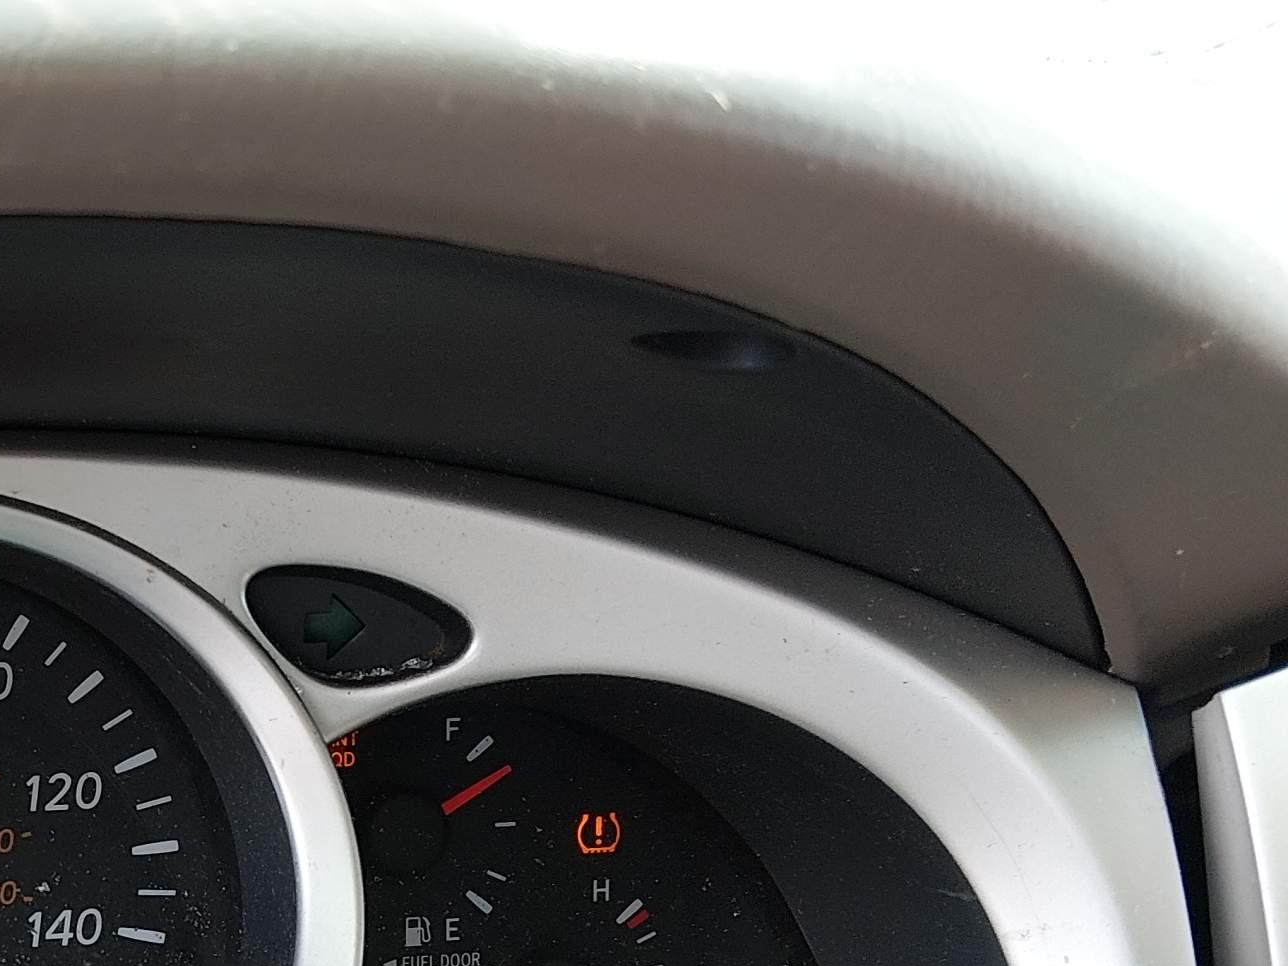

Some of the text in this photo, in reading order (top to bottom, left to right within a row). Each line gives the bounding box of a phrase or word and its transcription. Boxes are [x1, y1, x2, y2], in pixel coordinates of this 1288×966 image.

[446, 718, 461, 741] F
[26, 771, 103, 812] 120
[593, 879, 610, 902] H
[27, 908, 103, 948] 140
[446, 918, 461, 941] E
